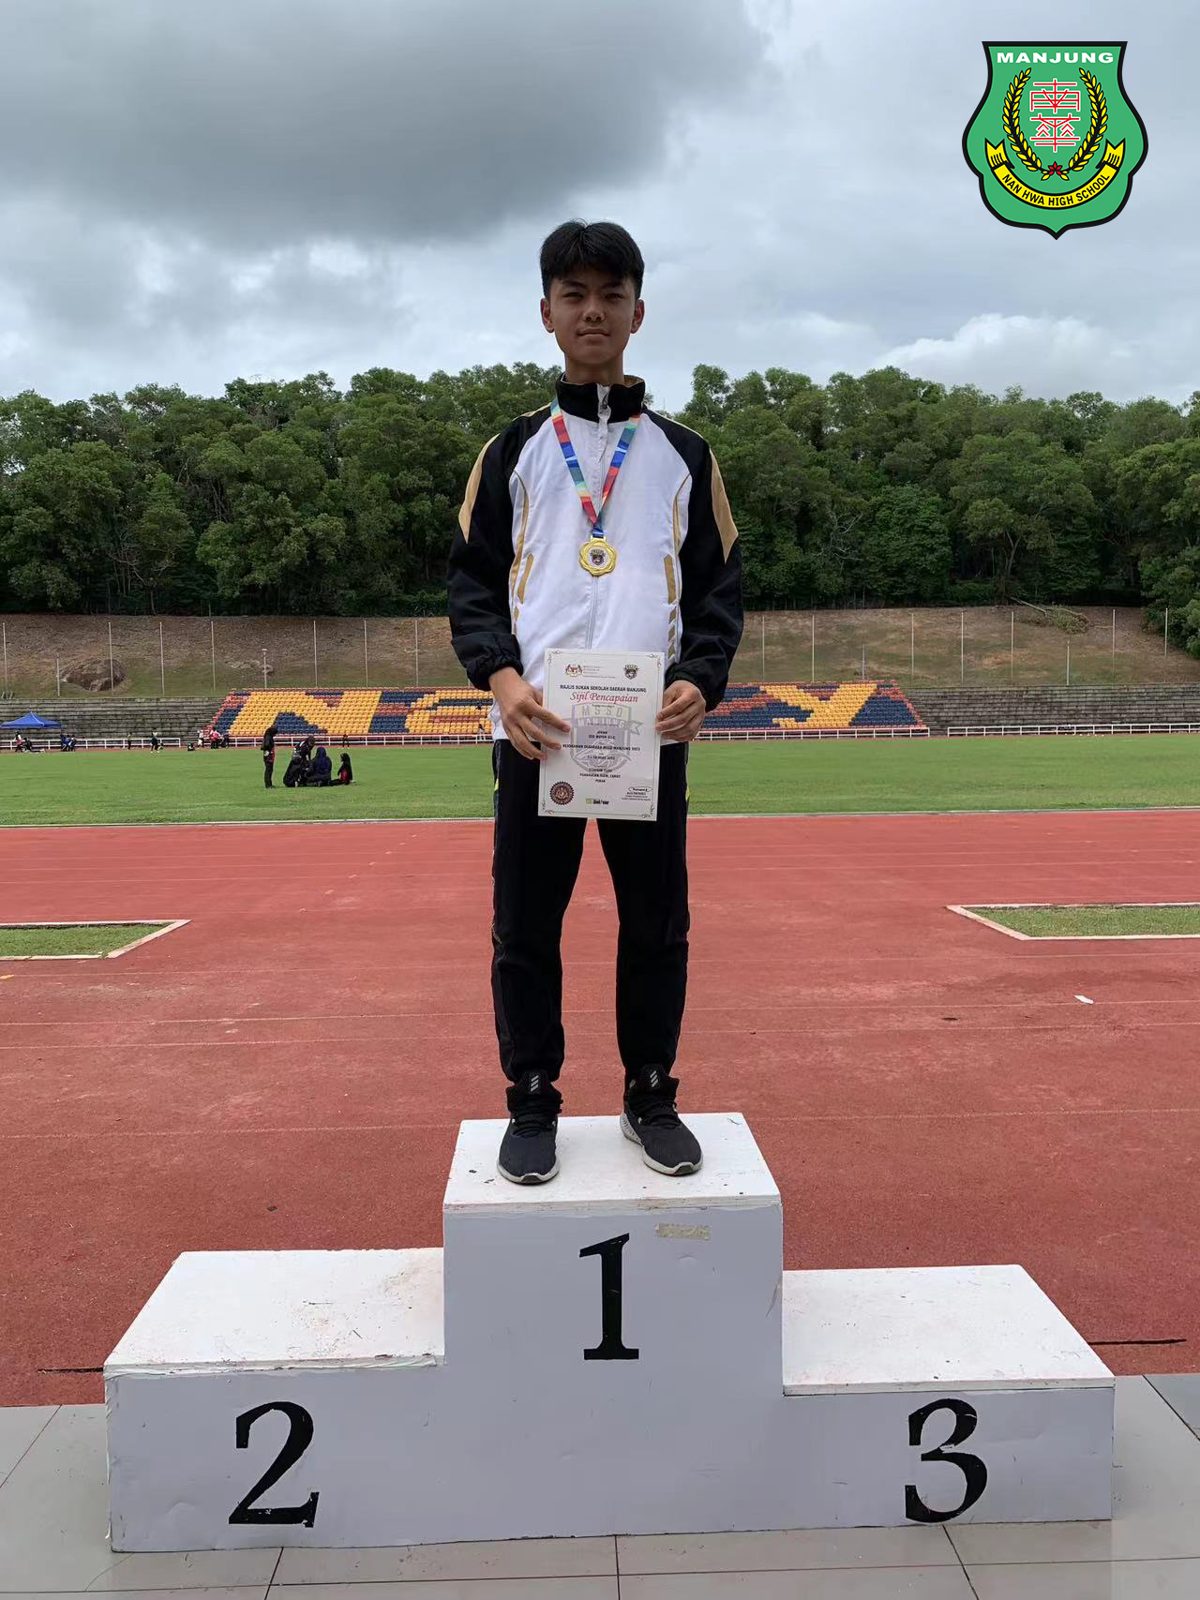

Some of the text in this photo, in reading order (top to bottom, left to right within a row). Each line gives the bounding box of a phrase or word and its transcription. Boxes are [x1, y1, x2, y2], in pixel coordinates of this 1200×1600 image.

[570, 690, 639, 704] Sijil Pencapaian
[579, 1232, 640, 1361] 1
[228, 1401, 320, 1528] 2
[905, 1398, 988, 1523] 3
